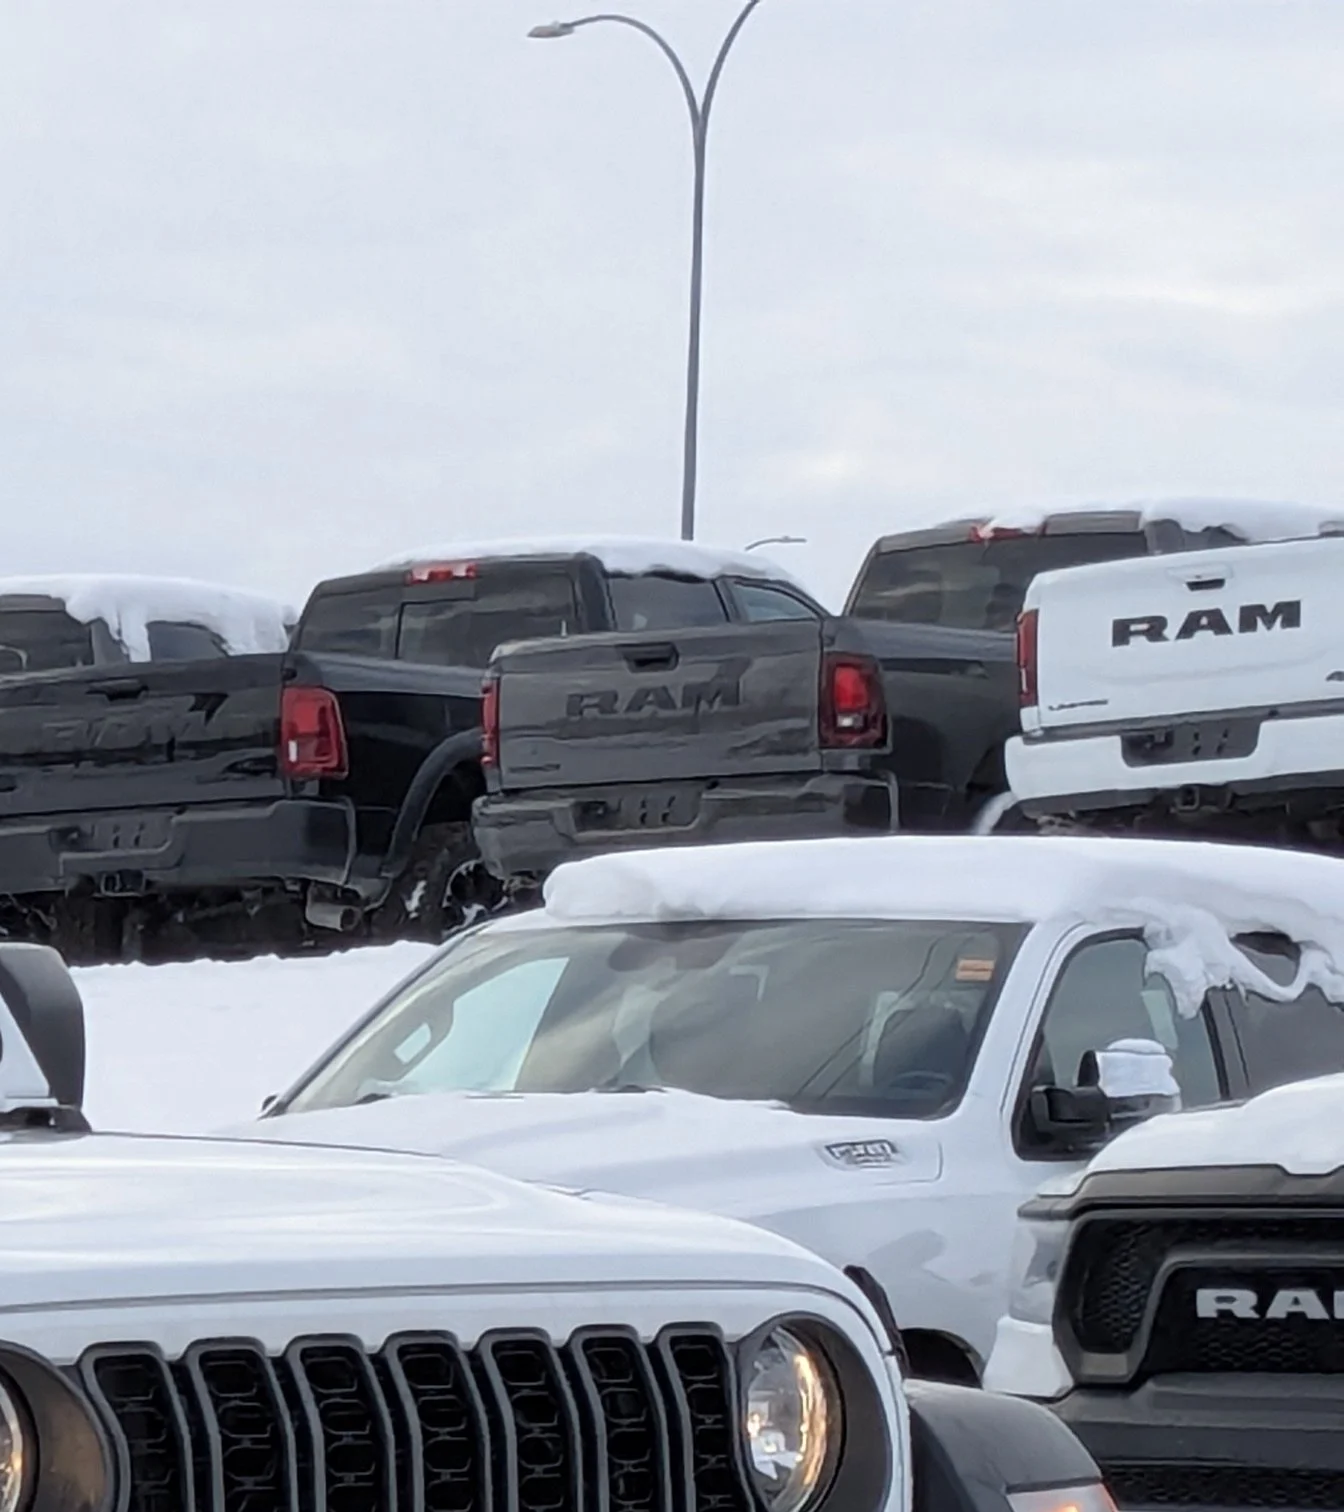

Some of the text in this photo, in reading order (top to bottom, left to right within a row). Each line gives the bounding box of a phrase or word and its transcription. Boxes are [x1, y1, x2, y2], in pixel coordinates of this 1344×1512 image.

[1111, 599, 1301, 648] RAM
[565, 677, 741, 717] RAM
[1195, 1287, 1344, 1320] RA
